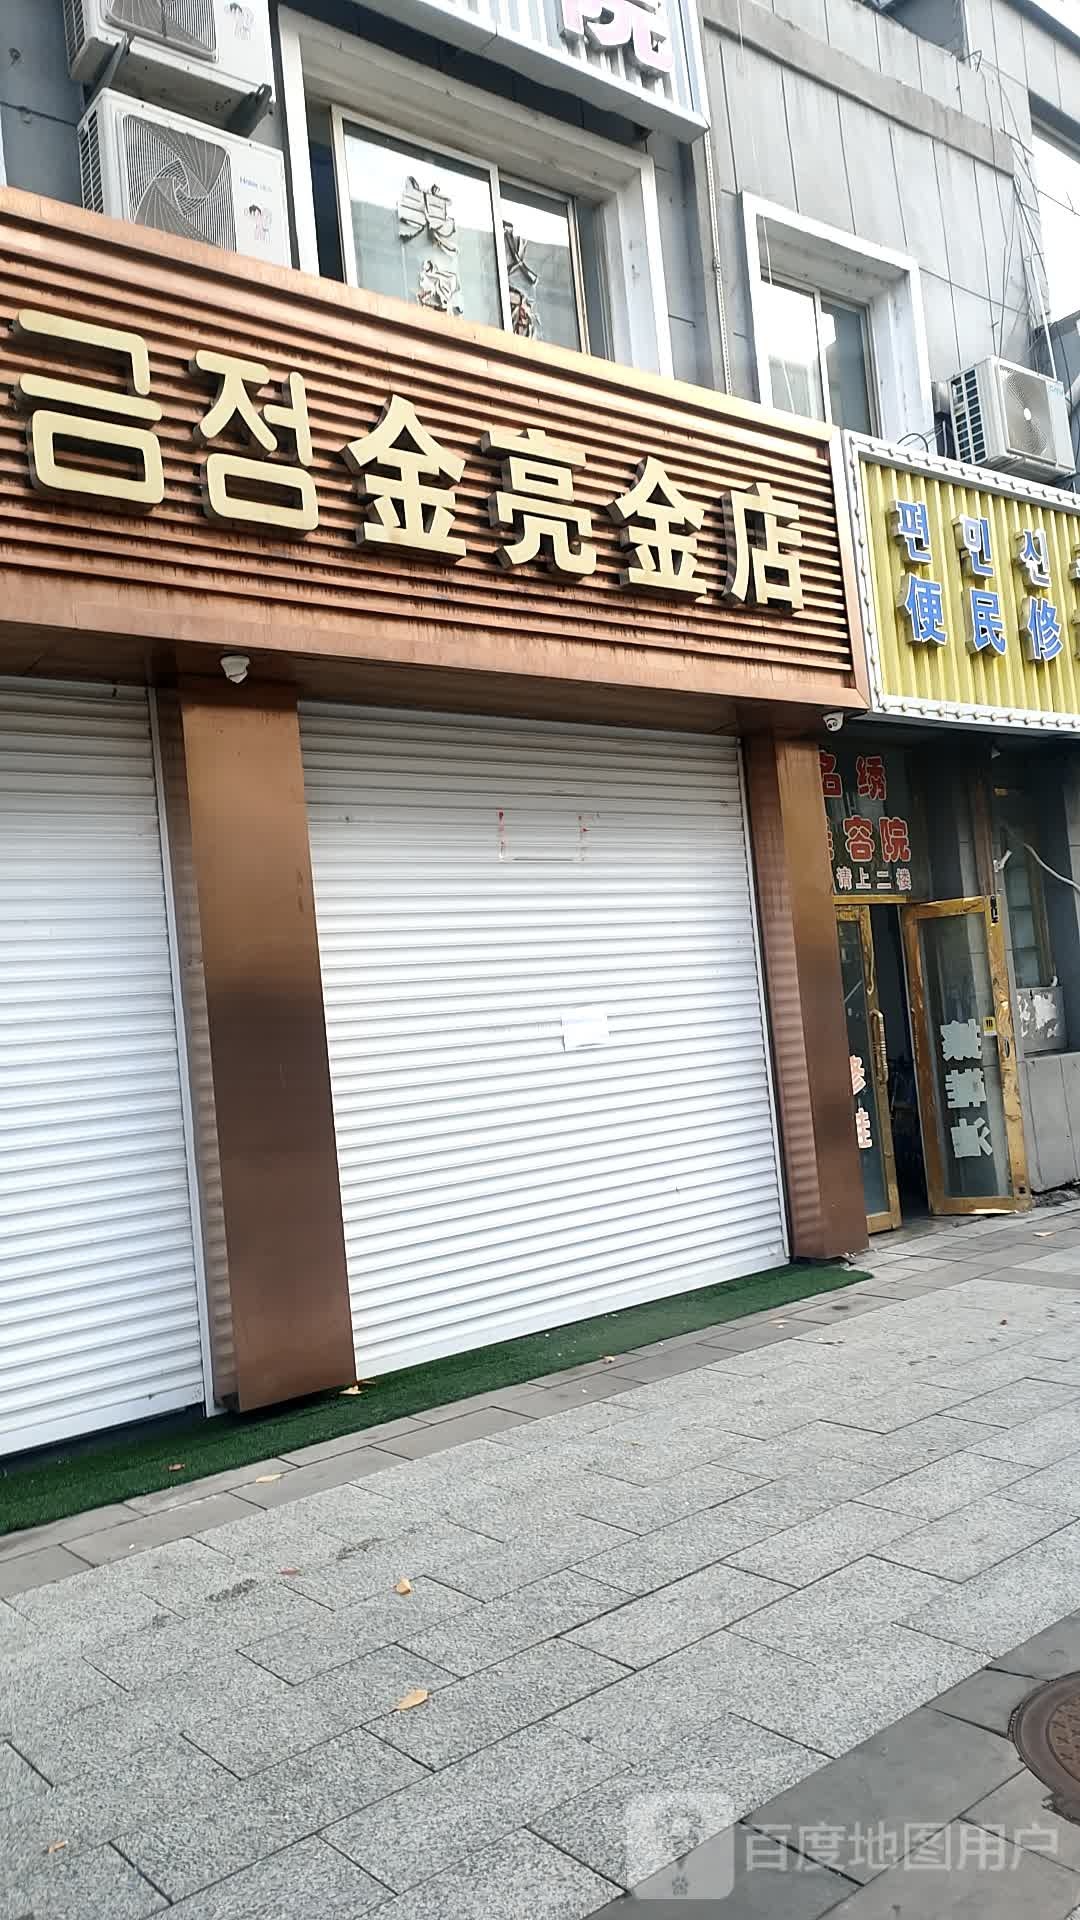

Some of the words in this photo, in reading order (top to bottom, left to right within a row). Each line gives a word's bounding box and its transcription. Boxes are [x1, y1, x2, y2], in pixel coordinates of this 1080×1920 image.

[17, 308, 320, 531] 금점
[343, 393, 804, 609] 金亮金店
[894, 499, 1080, 589] 편민신
[904, 573, 1080, 662] 便民修
[826, 814, 912, 862] 容院
[836, 865, 912, 891] 请上二楼
